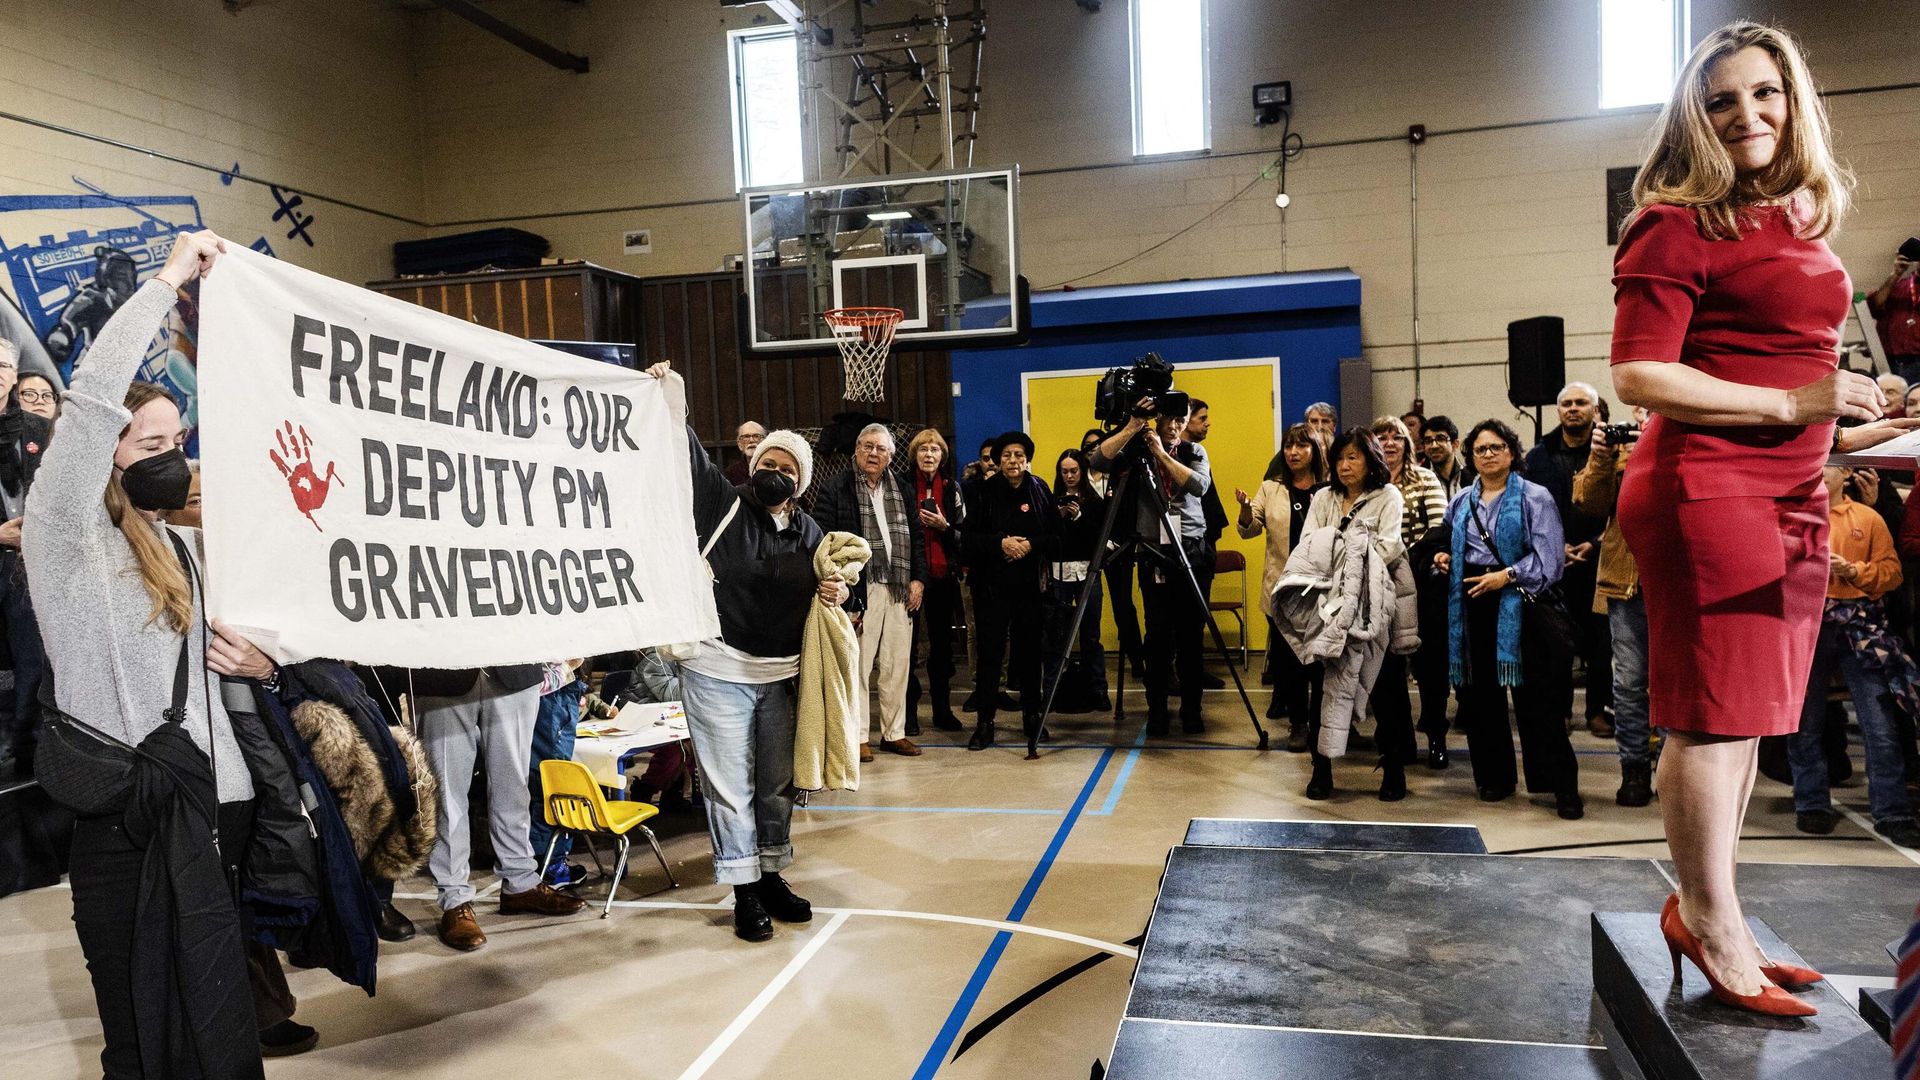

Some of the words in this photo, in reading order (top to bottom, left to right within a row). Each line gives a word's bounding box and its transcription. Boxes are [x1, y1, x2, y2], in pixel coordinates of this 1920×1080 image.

[290, 313, 551, 438] FREELAND:
[564, 385, 640, 453] OUR
[361, 438, 538, 529] DEPUTY
[552, 466, 612, 529] PM
[329, 538, 644, 623] GRAVEDIGGER
